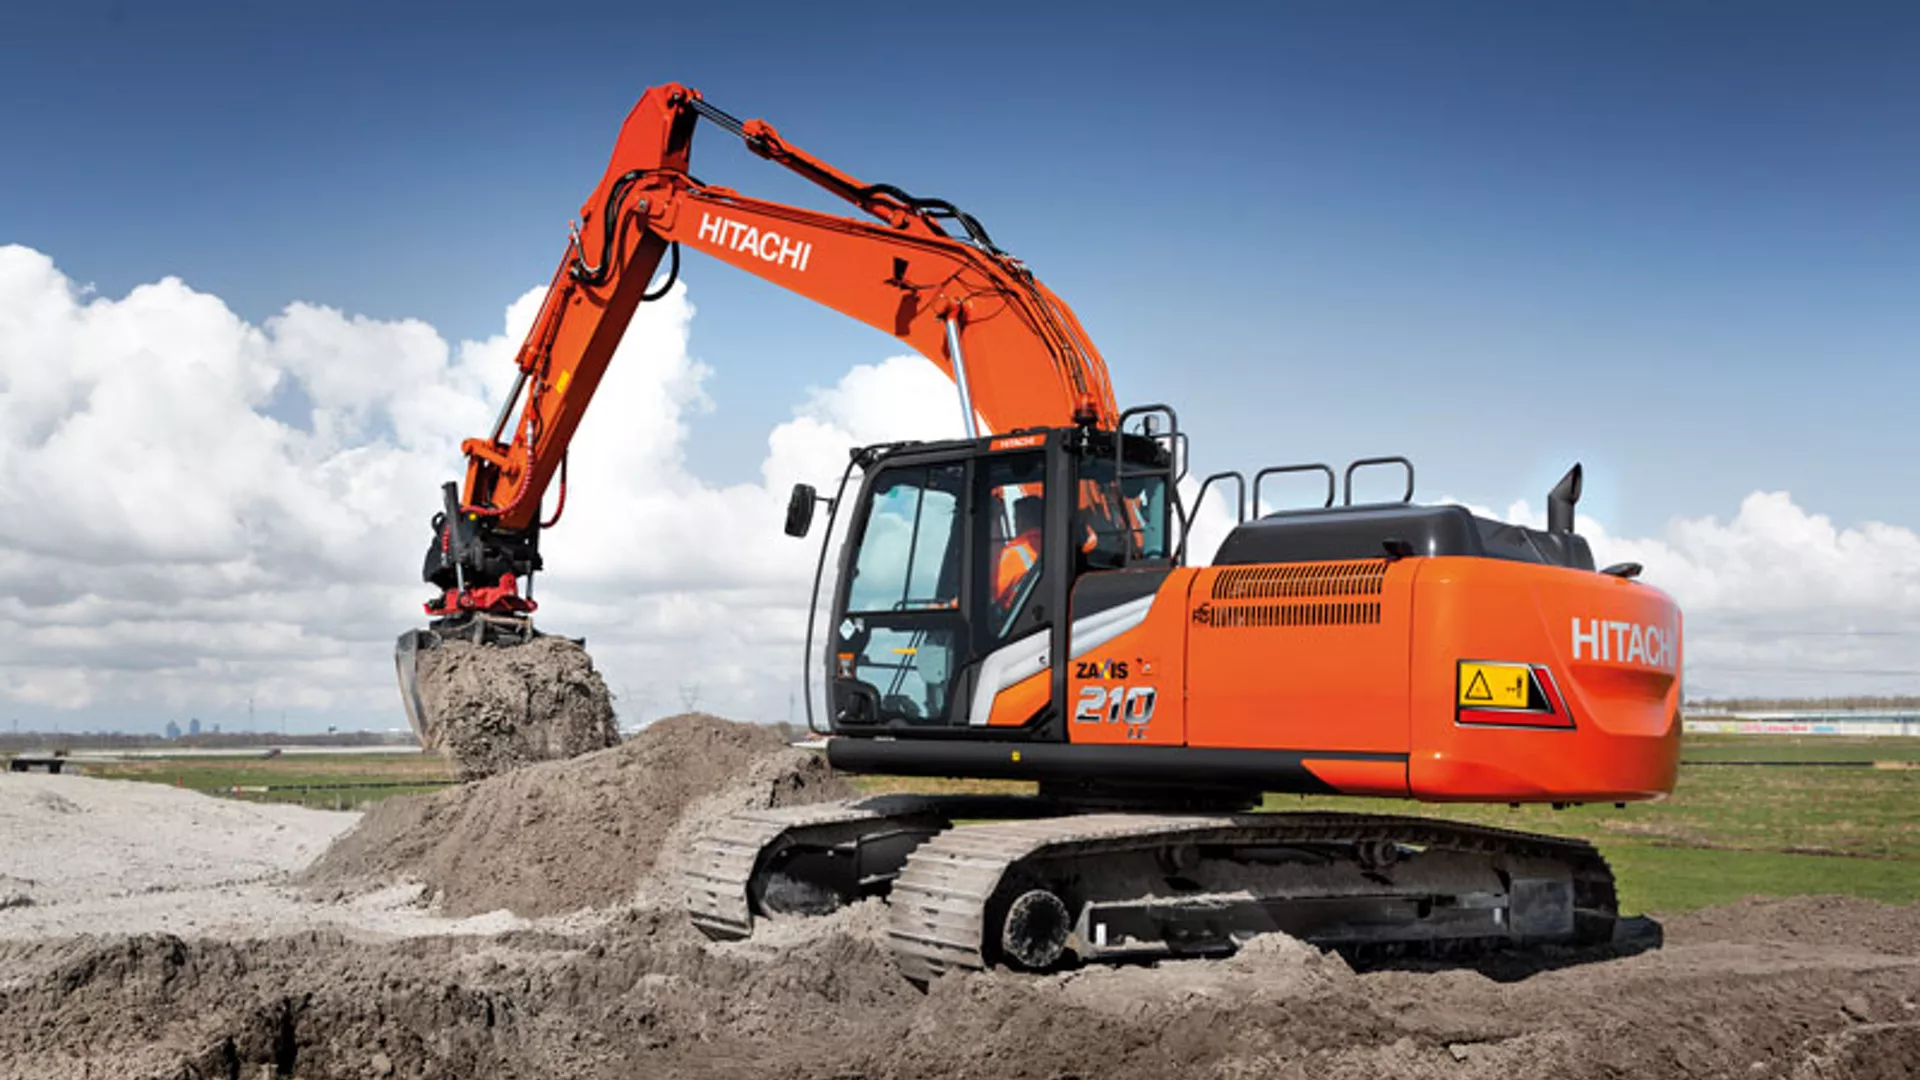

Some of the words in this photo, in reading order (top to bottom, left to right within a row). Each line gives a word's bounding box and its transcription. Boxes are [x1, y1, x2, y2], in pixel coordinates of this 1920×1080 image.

[698, 212, 812, 271] HITACHI
[1076, 658, 1129, 679] ZAXIS
[1075, 685, 1157, 724] 210
